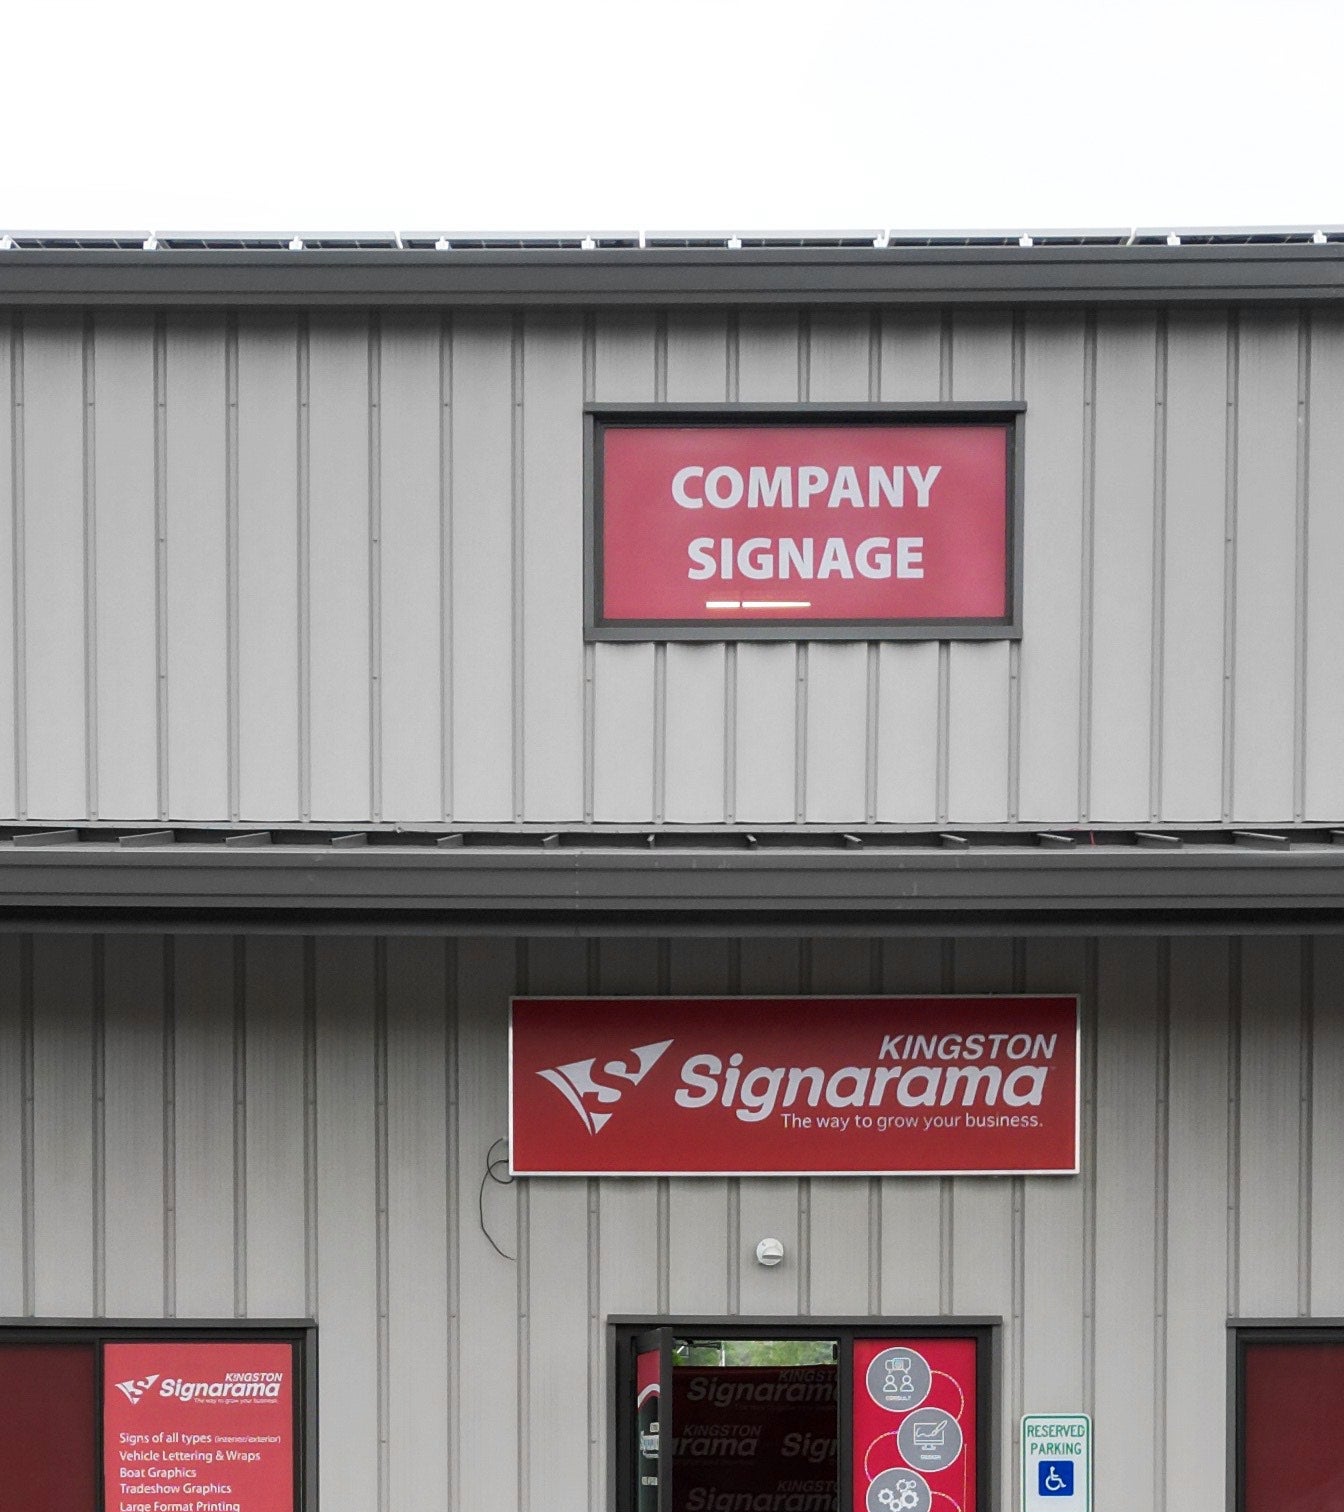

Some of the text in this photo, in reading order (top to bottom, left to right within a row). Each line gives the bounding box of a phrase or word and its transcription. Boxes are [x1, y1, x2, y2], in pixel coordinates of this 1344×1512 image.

[671, 466, 942, 509] COMPANY
[687, 537, 925, 580] SIGNAGE
[878, 1033, 1058, 1060] KINGSTON
[674, 1052, 1048, 1122] Signarama
[781, 1112, 1044, 1131] The way to grow your business.
[225, 1372, 283, 1382] KINGSTON
[159, 1378, 281, 1402] Signarama
[686, 1377, 838, 1407] Signaram
[1027, 1424, 1085, 1437] RESERVED
[119, 1432, 149, 1445] Signs
[152, 1432, 164, 1443] of
[166, 1432, 179, 1443] all
[181, 1433, 212, 1446] types
[1030, 1442, 1082, 1455] PARKING
[119, 1450, 261, 1464] Vehicle Lettering & Wraps
[120, 1467, 197, 1480] Boat Graphics
[120, 1483, 232, 1497] Tradeshow Graphics
[154, 1502, 193, 1512] Format
